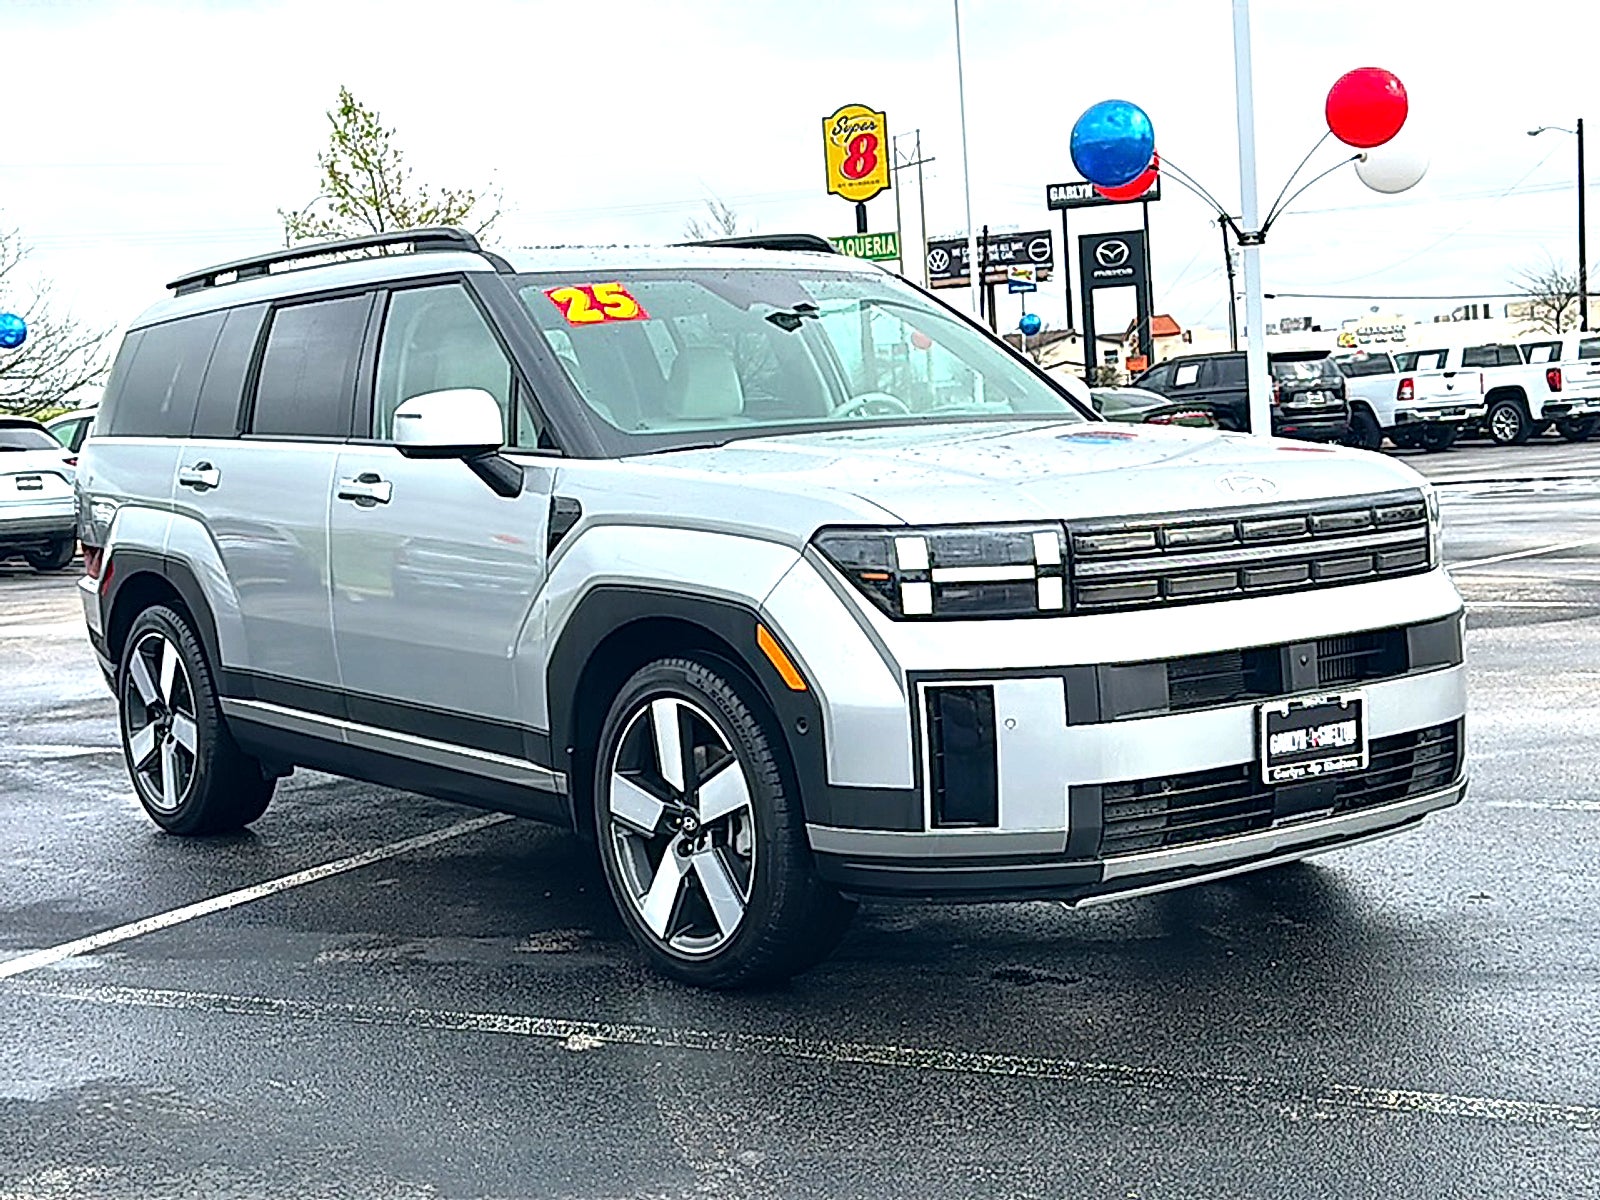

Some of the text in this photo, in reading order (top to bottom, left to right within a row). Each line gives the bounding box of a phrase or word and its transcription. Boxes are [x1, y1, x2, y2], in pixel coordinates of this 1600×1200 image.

[832, 116, 877, 143] Super
[843, 133, 878, 180] 8
[1093, 267, 1133, 278] mazda
[550, 282, 638, 322] 25
